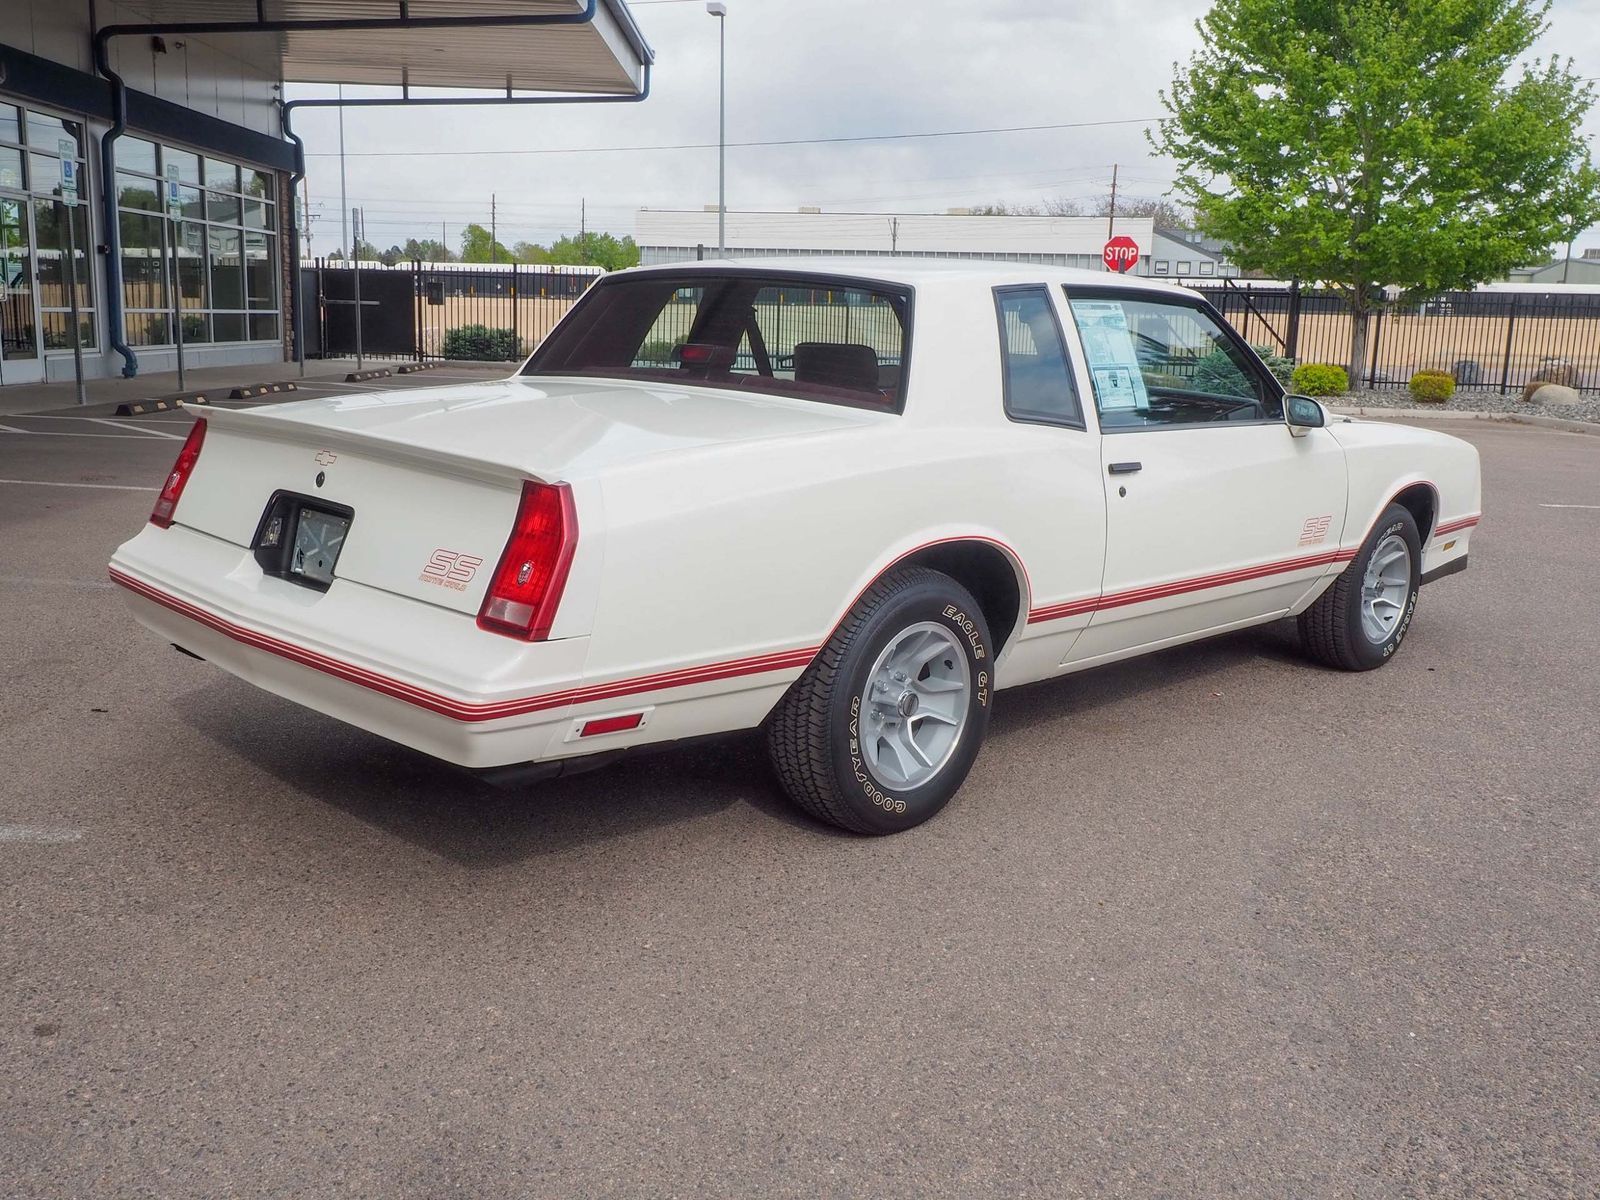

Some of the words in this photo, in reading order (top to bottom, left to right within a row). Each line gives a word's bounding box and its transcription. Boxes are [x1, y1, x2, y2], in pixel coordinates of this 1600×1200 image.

[1105, 246, 1137, 260] STOP
[1300, 515, 1332, 540] SS
[423, 548, 483, 583] SS
[942, 604, 986, 660] EAGLE
[977, 671, 989, 707] GT
[849, 695, 907, 813] GOODYEAR
